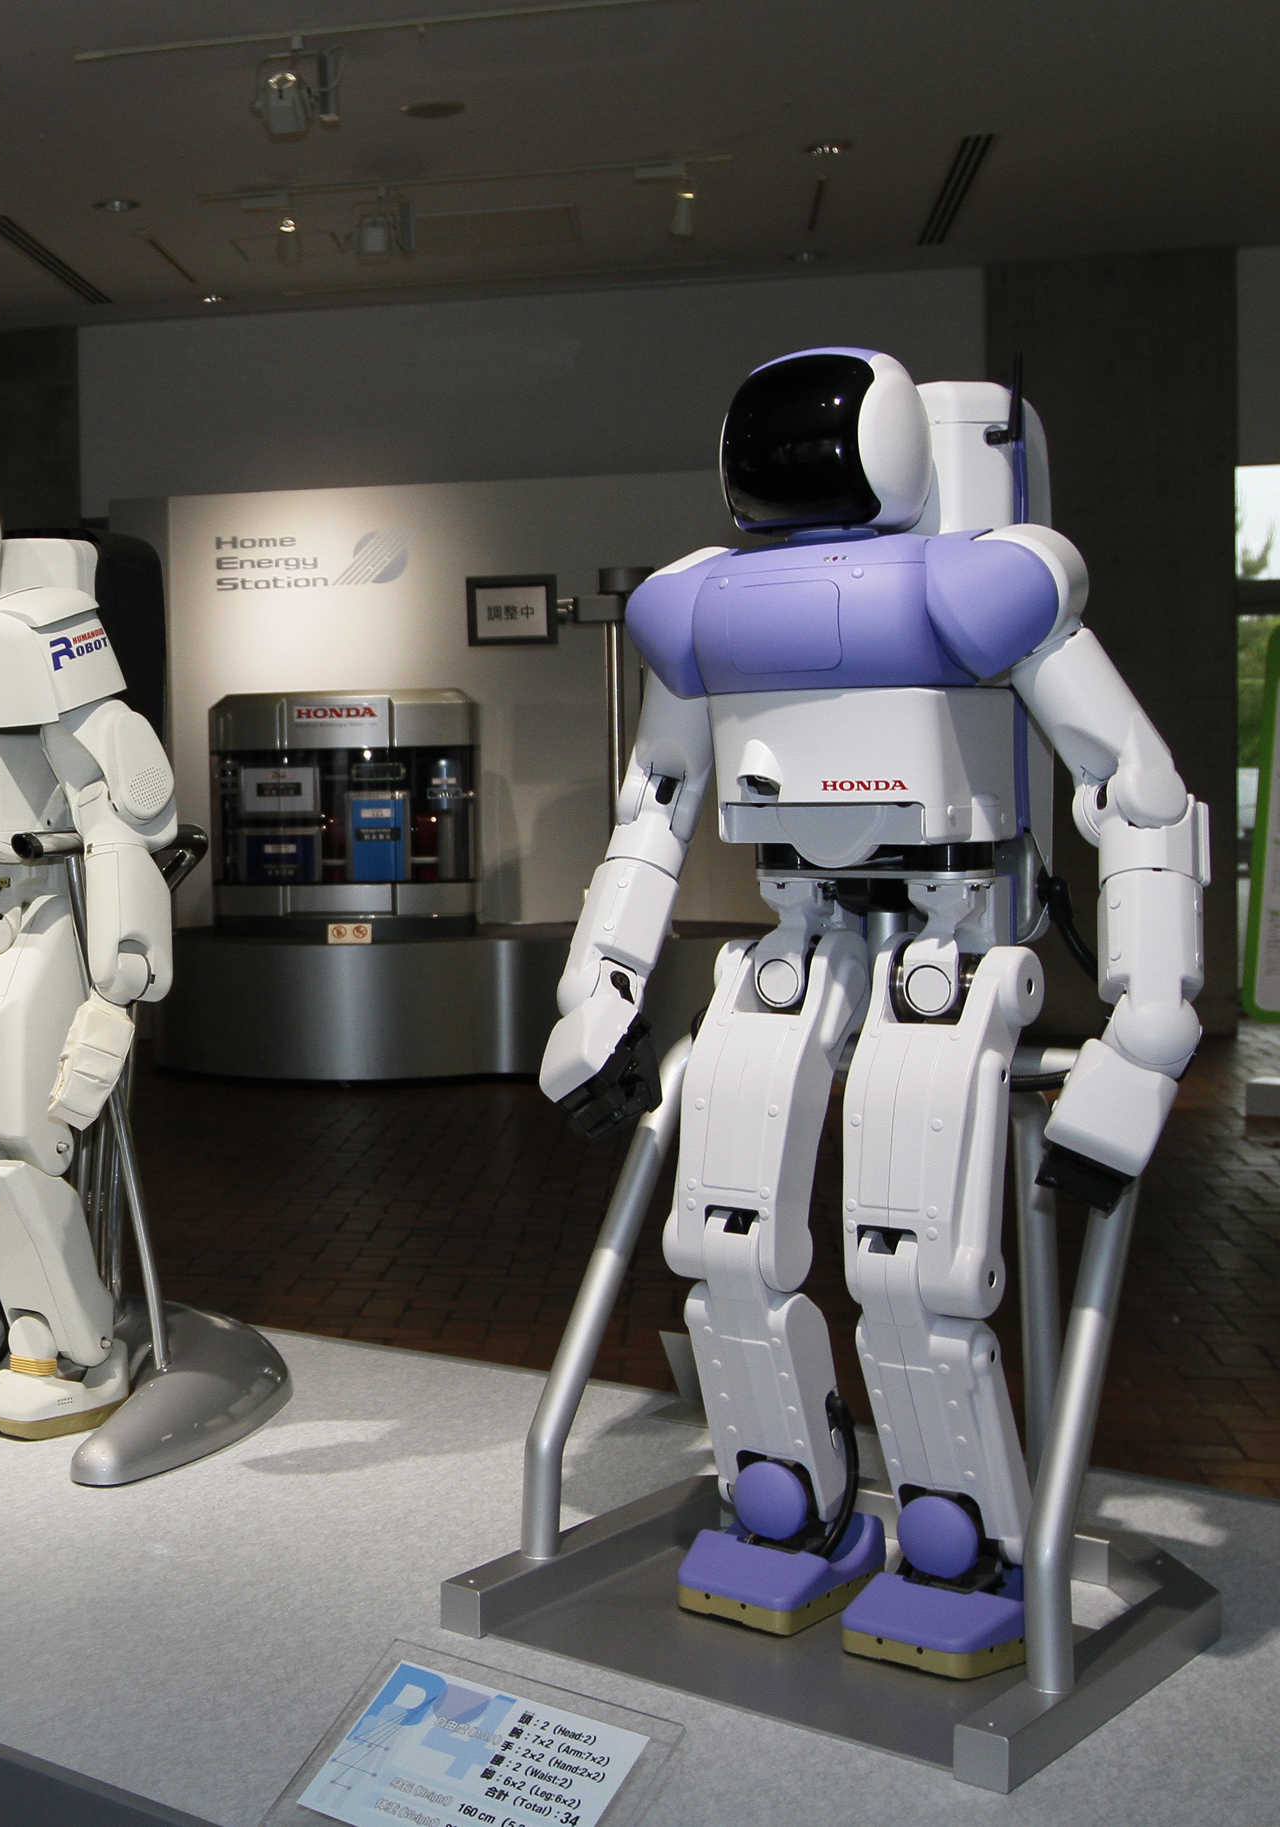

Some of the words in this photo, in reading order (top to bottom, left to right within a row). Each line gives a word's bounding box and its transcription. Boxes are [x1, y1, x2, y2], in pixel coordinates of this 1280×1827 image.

[215, 536, 296, 550] Home
[216, 556, 318, 570] Energy
[217, 576, 329, 591] Station
[487, 604, 535, 621] 調整中
[49, 636, 108, 671] ROBOT
[296, 707, 377, 719] HONDA
[821, 780, 909, 791] HONDA
[552, 1724, 597, 1746] (Head:2)
[524, 1765, 573, 1789] (Waist:2)
[485, 1786, 510, 1801] 合計
[458, 1803, 479, 1818] 160
[477, 1812, 496, 1825] cm
